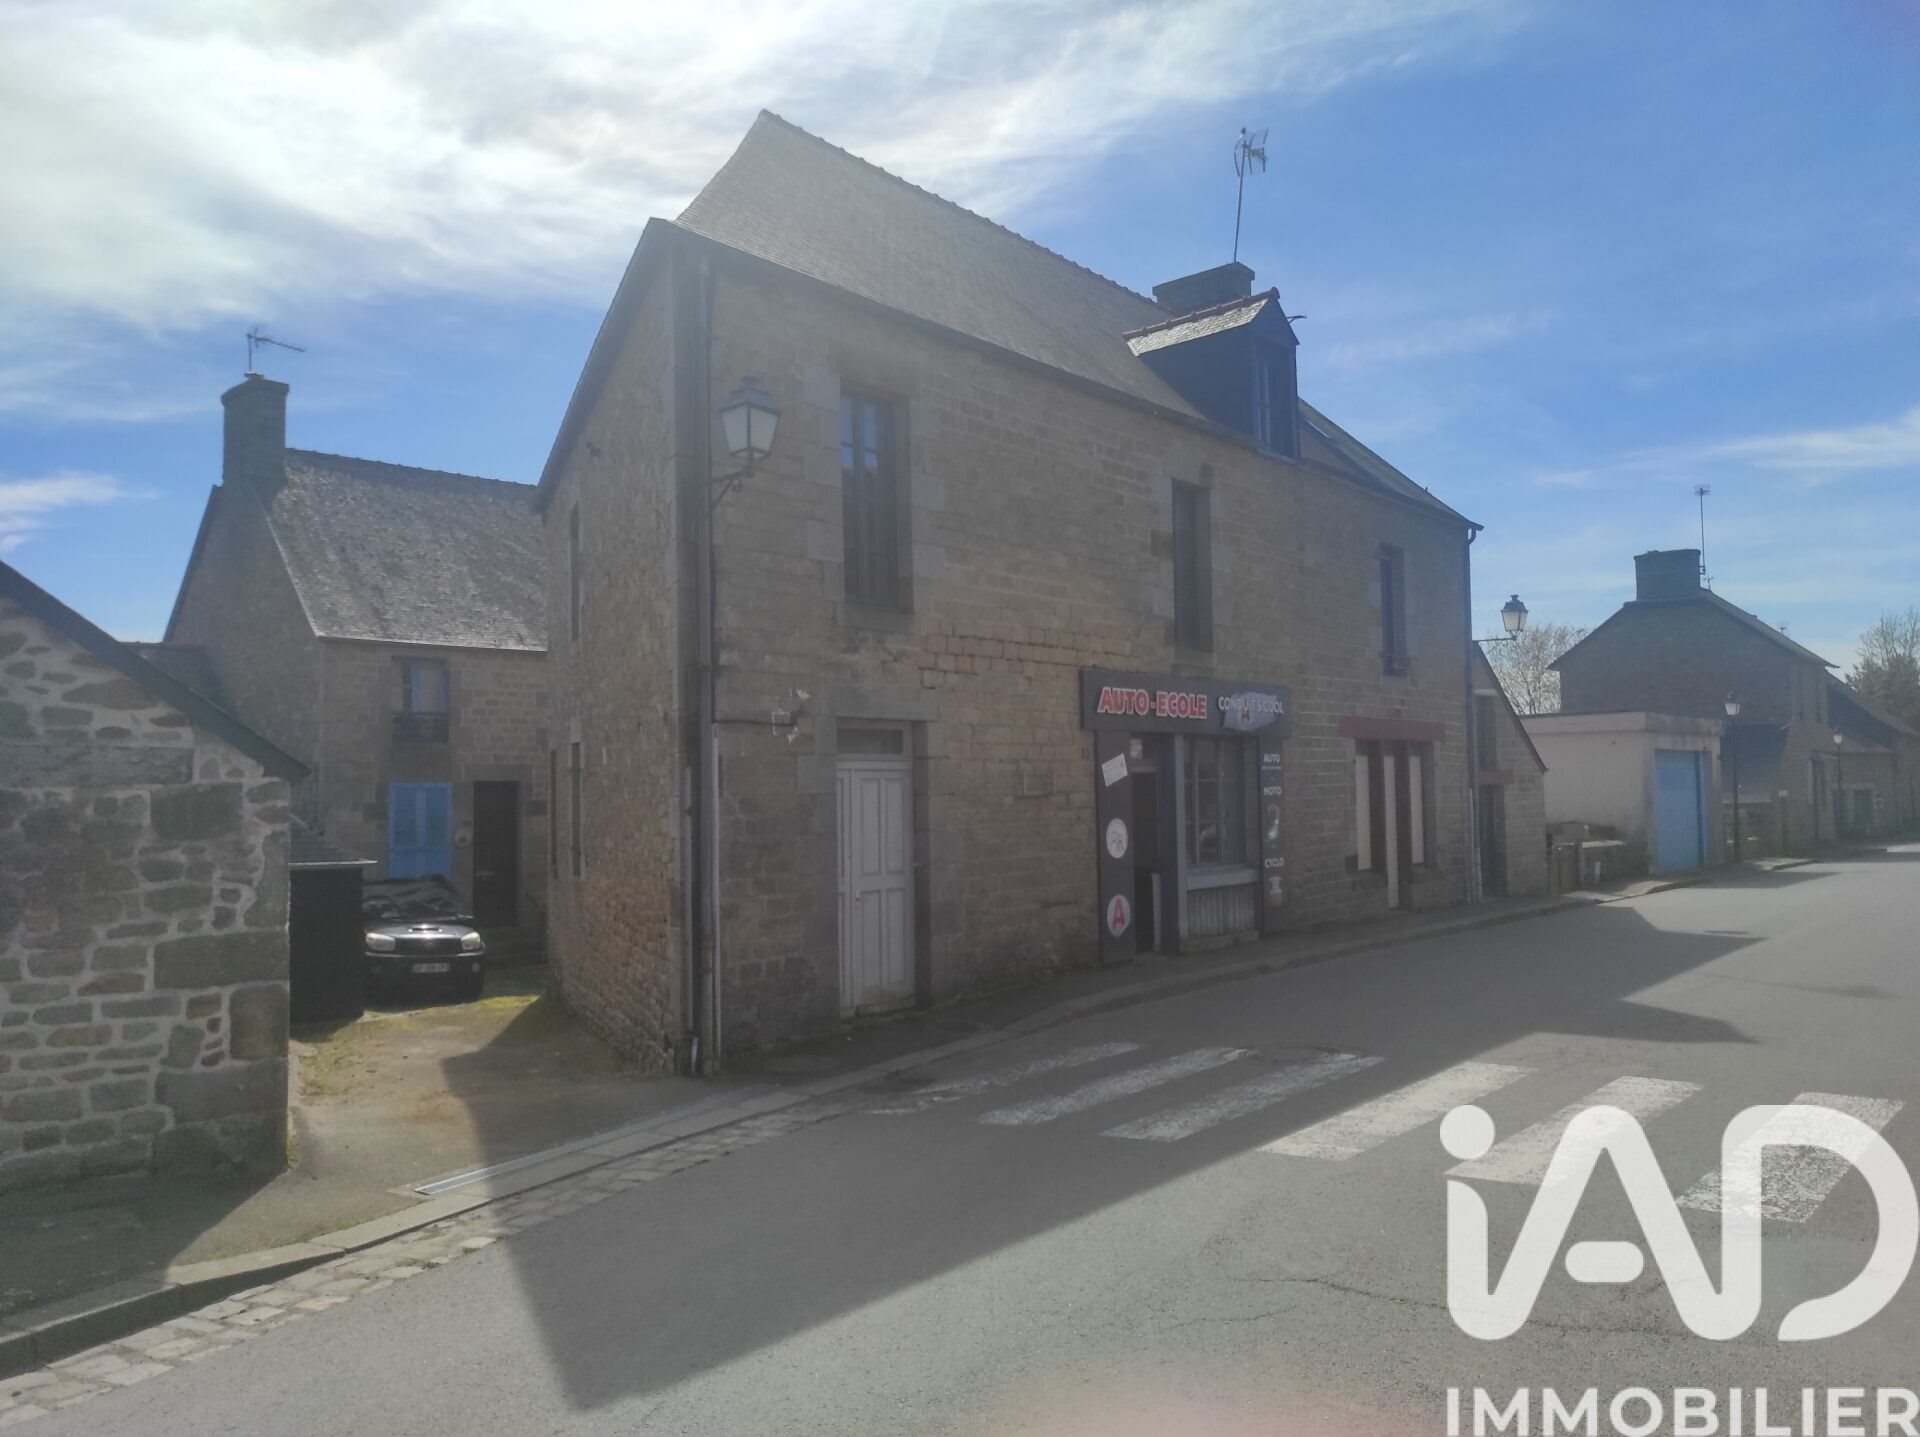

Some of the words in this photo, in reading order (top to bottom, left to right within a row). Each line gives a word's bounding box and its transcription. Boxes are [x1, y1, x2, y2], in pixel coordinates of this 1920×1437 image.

[1263, 753, 1281, 763] AUTO
[1263, 786, 1282, 796] MOTO
[1264, 857, 1285, 868] CYCLO
[1112, 897, 1126, 929] A
